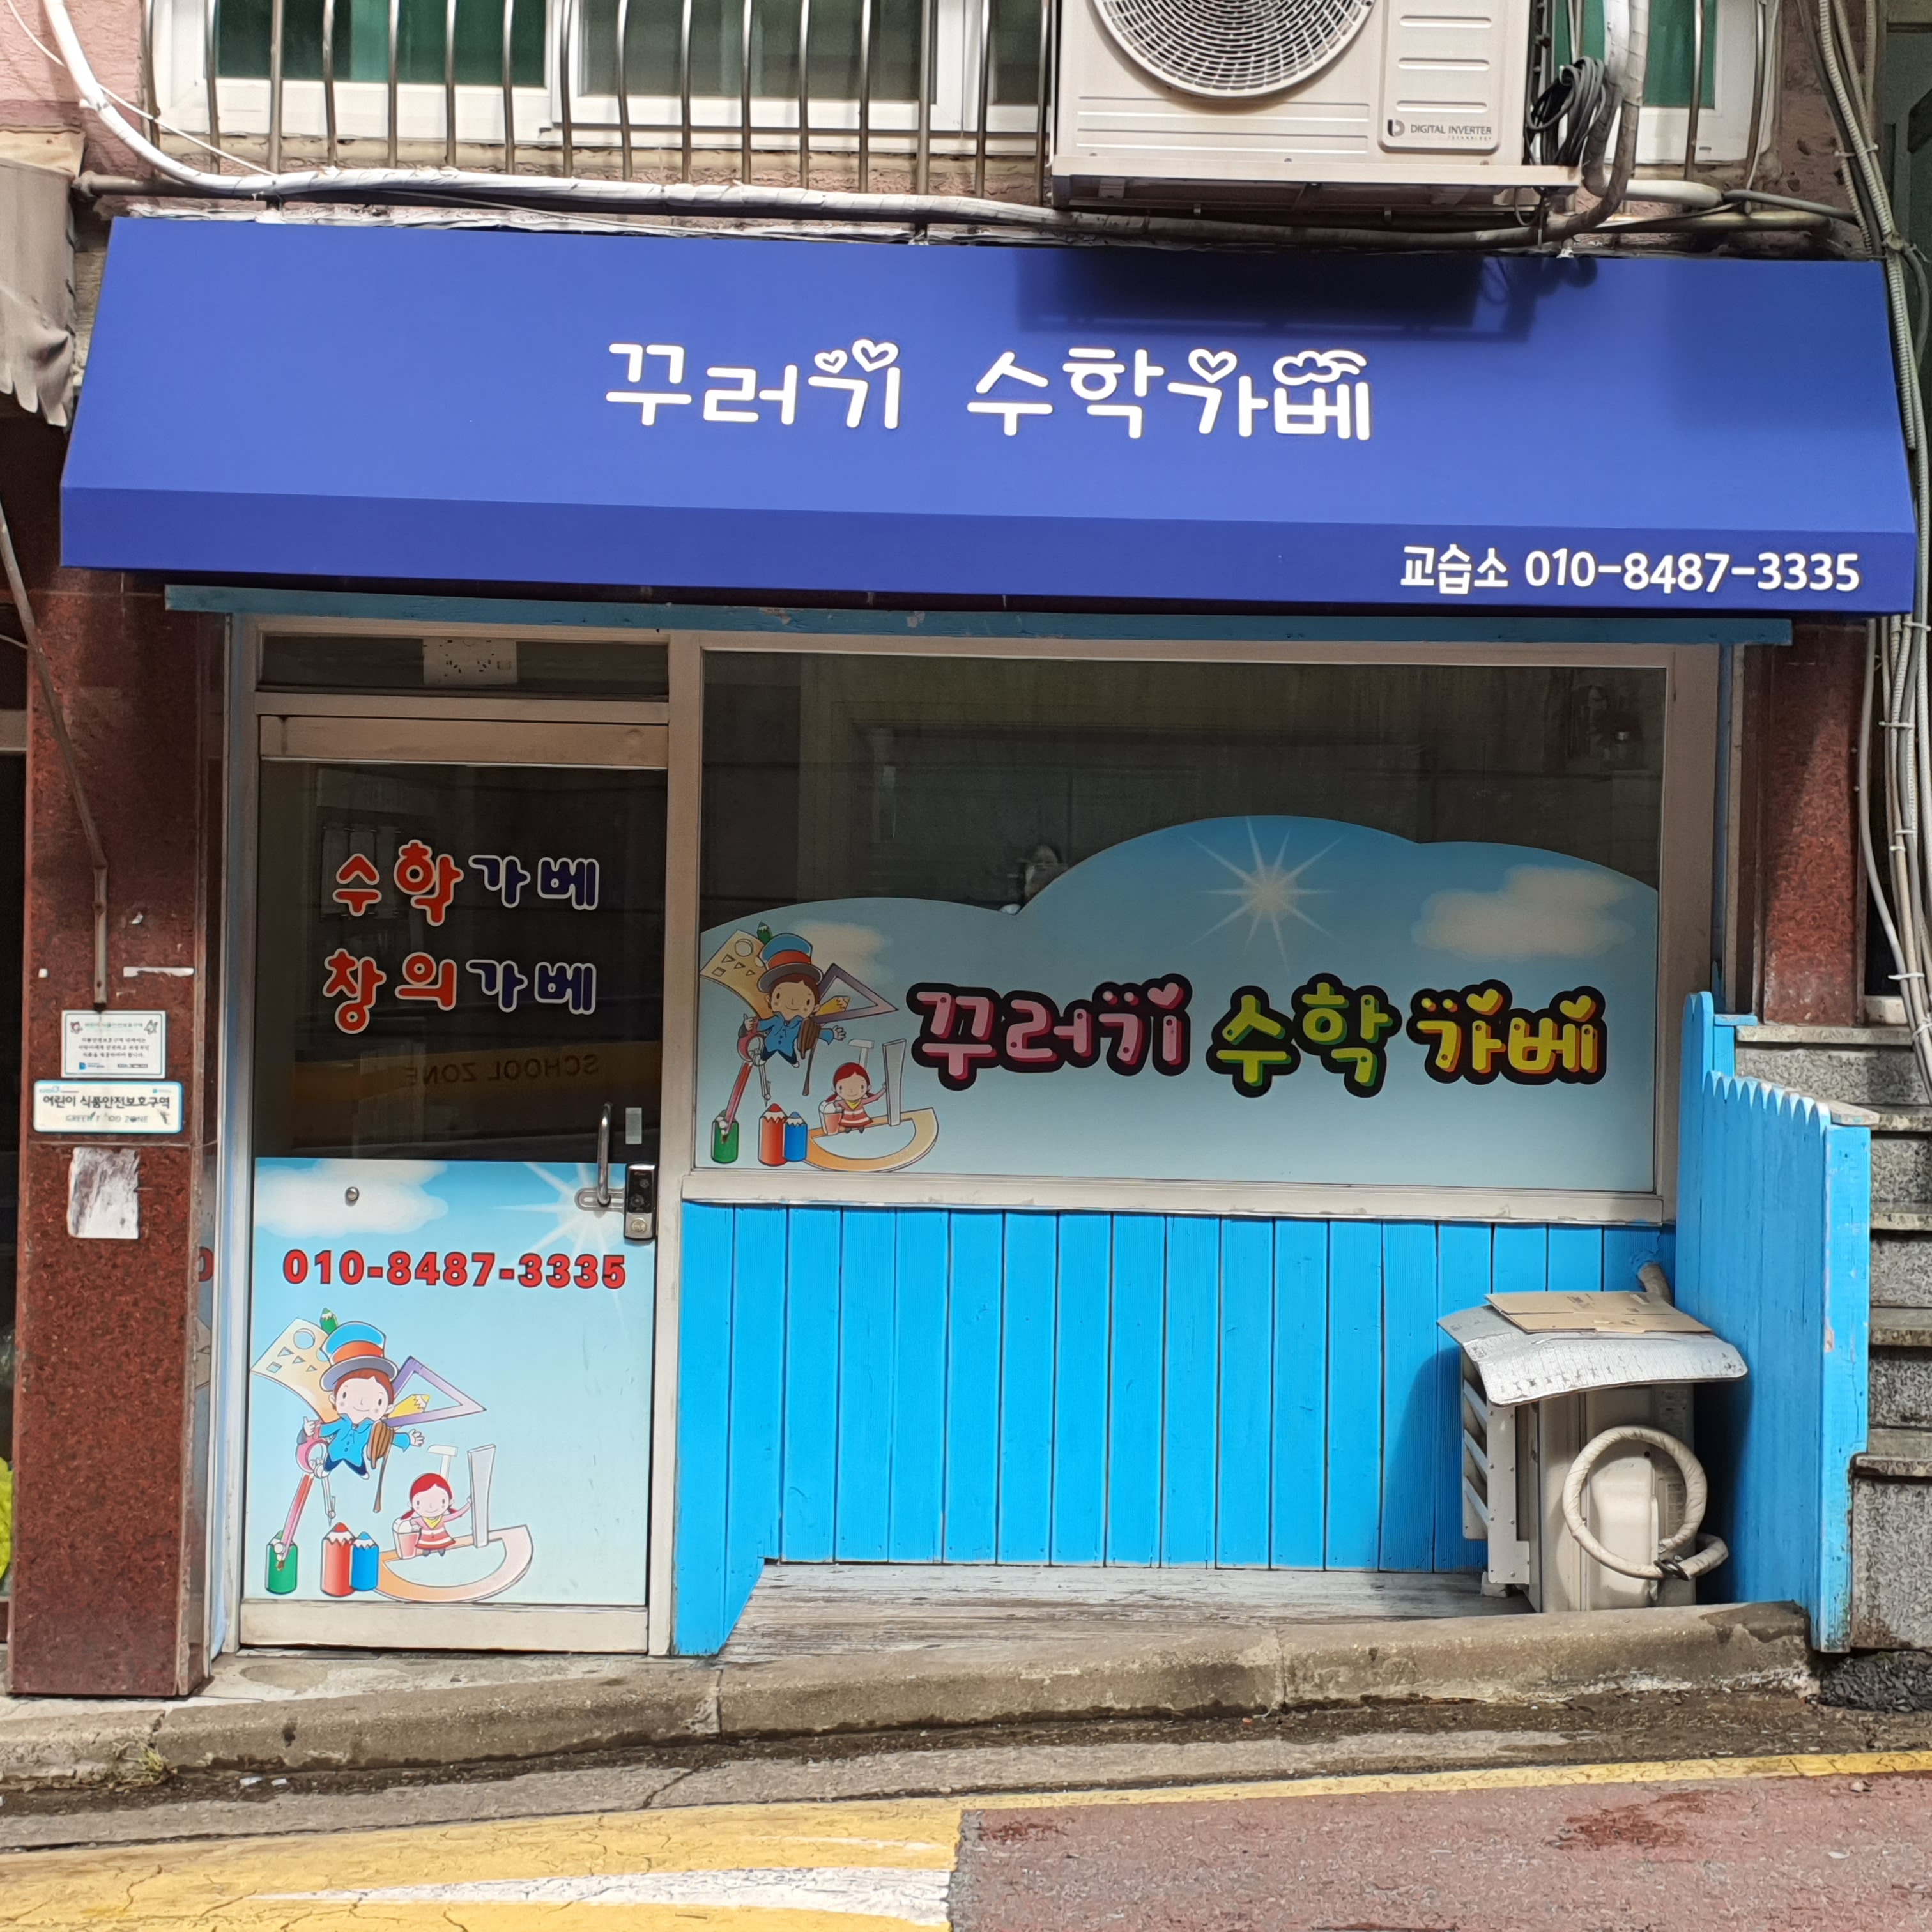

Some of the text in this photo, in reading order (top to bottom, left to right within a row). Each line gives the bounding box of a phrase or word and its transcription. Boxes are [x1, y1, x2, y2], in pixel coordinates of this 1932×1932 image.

[1410, 124, 1492, 135] DIGITAL INVERTER
[606, 339, 1370, 441] 꾸러기 수학가베
[1400, 544, 1860, 595] 교습소 010-8487-3335
[906, 972, 1193, 1092] 꾸러기
[43, 1095, 170, 1109] 어린이 식품안전보호구역
[96, 1114, 121, 1123] FOD
[282, 1248, 627, 1289] 010-8487-3335
